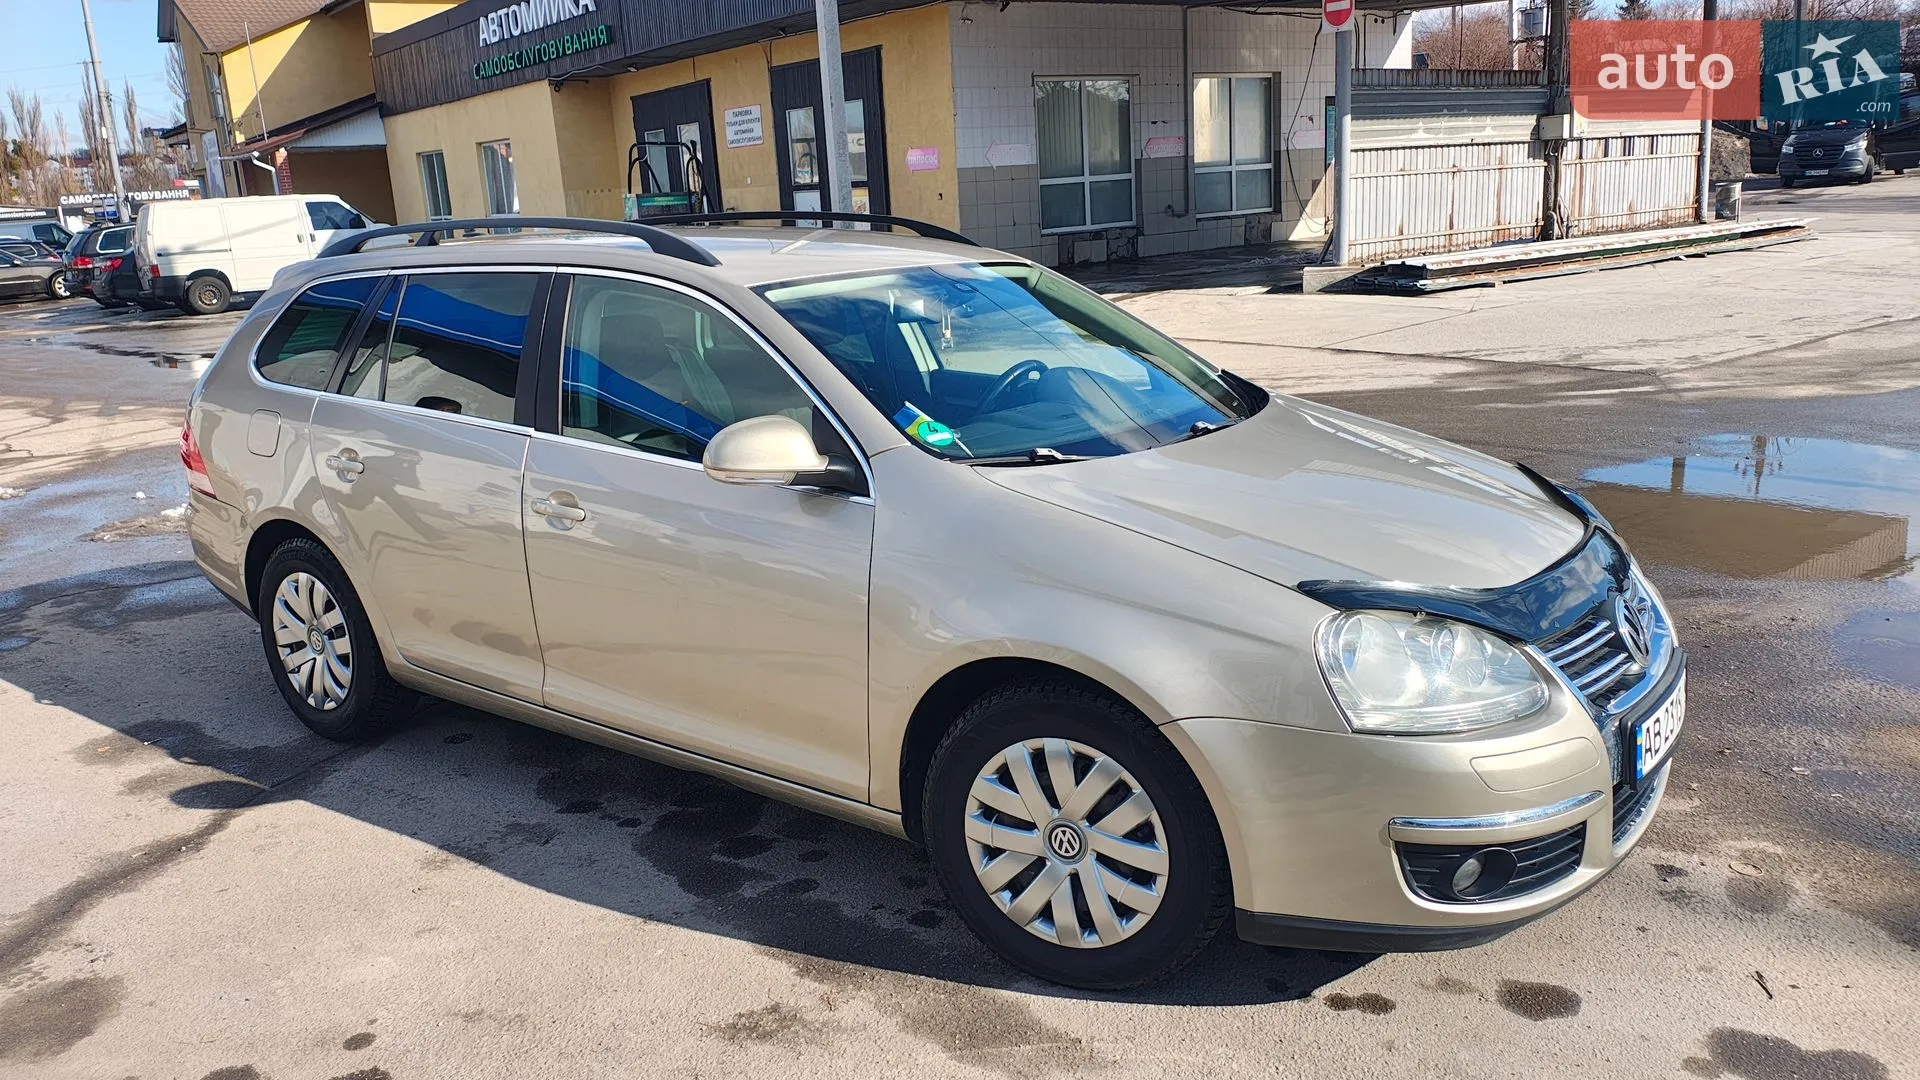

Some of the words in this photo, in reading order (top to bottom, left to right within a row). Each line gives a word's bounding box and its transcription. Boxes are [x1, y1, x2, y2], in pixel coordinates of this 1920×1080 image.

[473, 25, 608, 80] САМООБСЛУГОВУВАННЯ
[60, 189, 190, 205] САМОГОВУВАННЯ
[927, 421, 939, 433] 4
